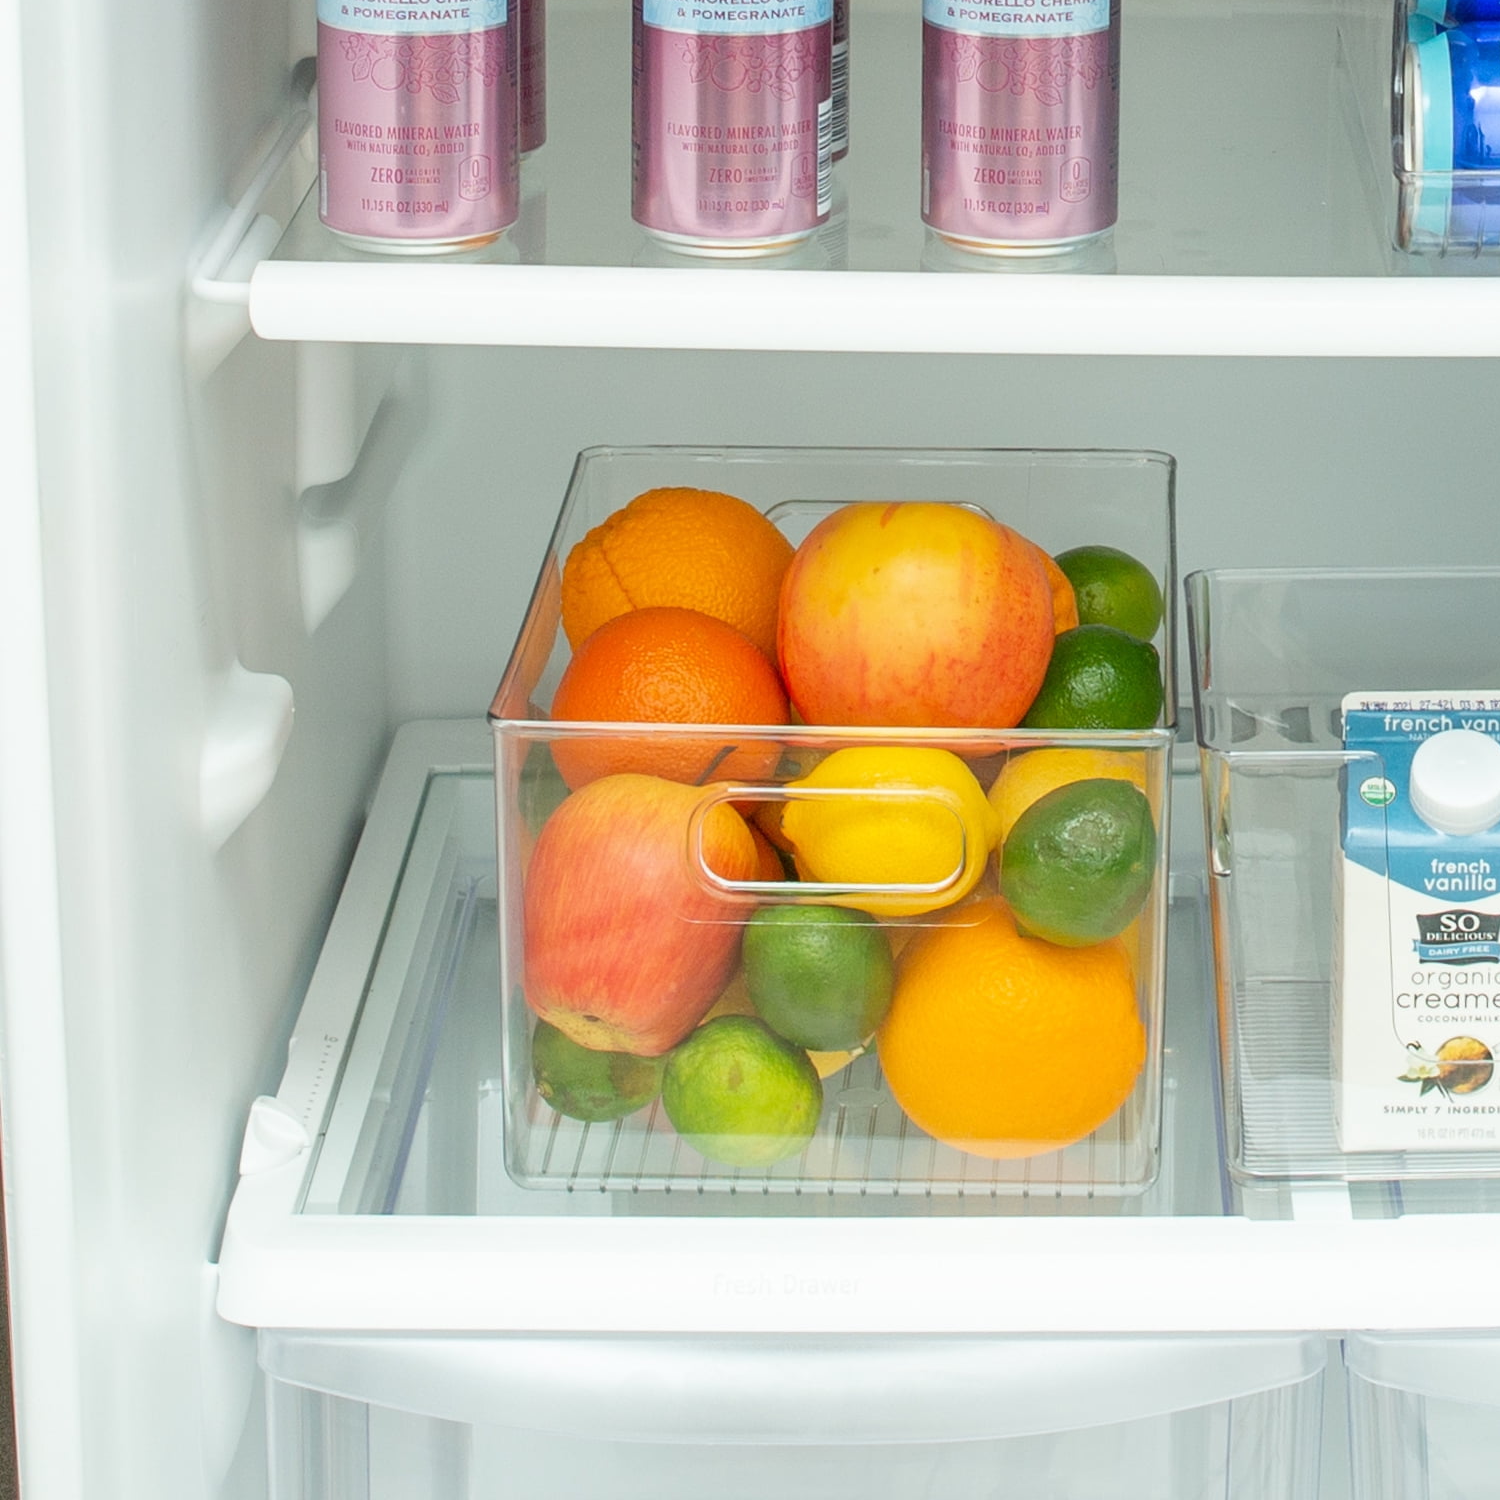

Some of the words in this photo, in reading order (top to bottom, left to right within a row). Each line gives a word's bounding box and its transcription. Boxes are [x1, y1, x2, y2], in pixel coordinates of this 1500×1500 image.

[353, 7, 470, 20] POMEGRANATE
[692, 6, 806, 21] POMEGRANATE
[959, 9, 1074, 23] POMEGRANATE
[335, 119, 383, 140] FLAVORED
[387, 125, 440, 141] MINERAL
[444, 122, 480, 139] WATER
[726, 125, 778, 140] MINERAL
[939, 119, 987, 141] FLAVORED
[990, 125, 1042, 141] MINERAL
[1046, 125, 1082, 140] WATER
[371, 167, 403, 185] ZERO
[709, 168, 742, 184] ZERO
[974, 167, 1006, 185] ZERO
[1384, 714, 1453, 732] french
[1430, 859, 1490, 874] french
[1424, 874, 1497, 892] vanilla
[1440, 914, 1480, 933] SO
[1426, 931, 1496, 942] DELICIOUS
[1428, 947, 1460, 957] DAIRY
[1462, 944, 1490, 954] FREE
[1417, 1015, 1500, 1023] COCONUTMILK
[1384, 1105, 1428, 1115] SIMPLY
[1434, 1106, 1441, 1115] 7
